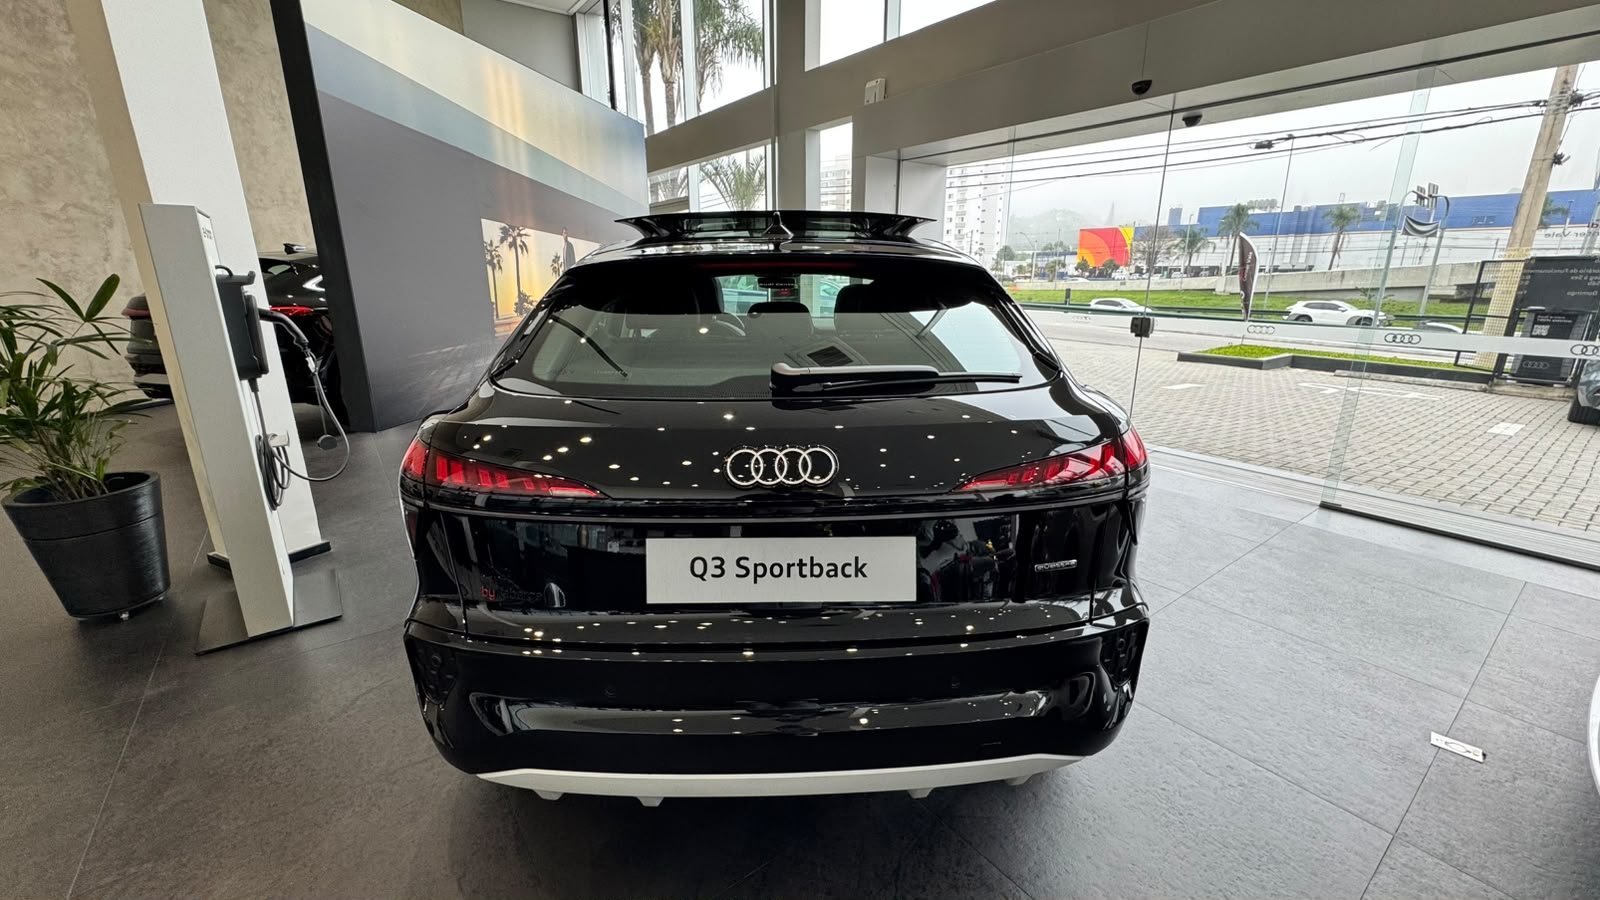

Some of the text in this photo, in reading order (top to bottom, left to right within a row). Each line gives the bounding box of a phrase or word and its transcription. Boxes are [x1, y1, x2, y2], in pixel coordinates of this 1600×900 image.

[689, 556, 868, 585] Q3 Sportback
[480, 585, 496, 601] by
